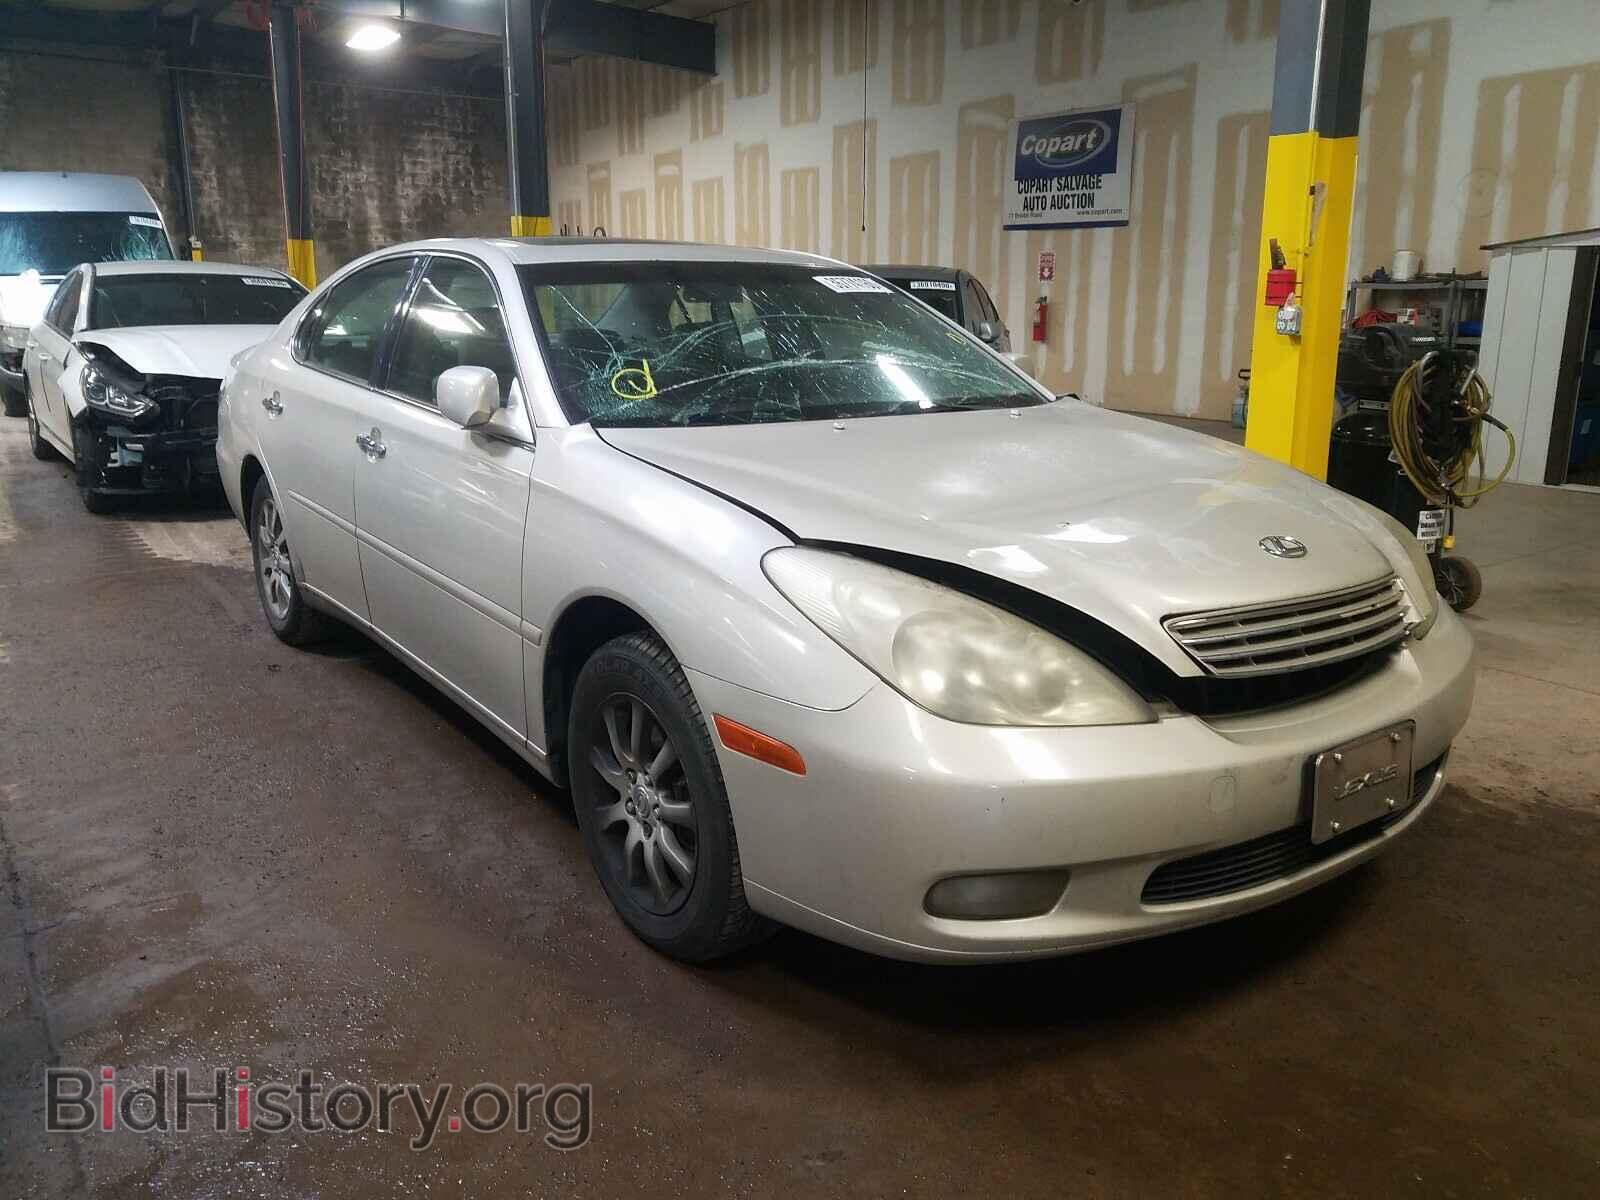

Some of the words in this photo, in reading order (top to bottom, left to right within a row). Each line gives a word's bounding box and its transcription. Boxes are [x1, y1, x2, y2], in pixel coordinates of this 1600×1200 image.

[1020, 127, 1098, 158] Copart
[1017, 177, 1053, 194] COPART
[1057, 174, 1102, 191] SALVAGE
[1023, 195, 1047, 212] AUTO
[1050, 193, 1095, 210] AUCTION
